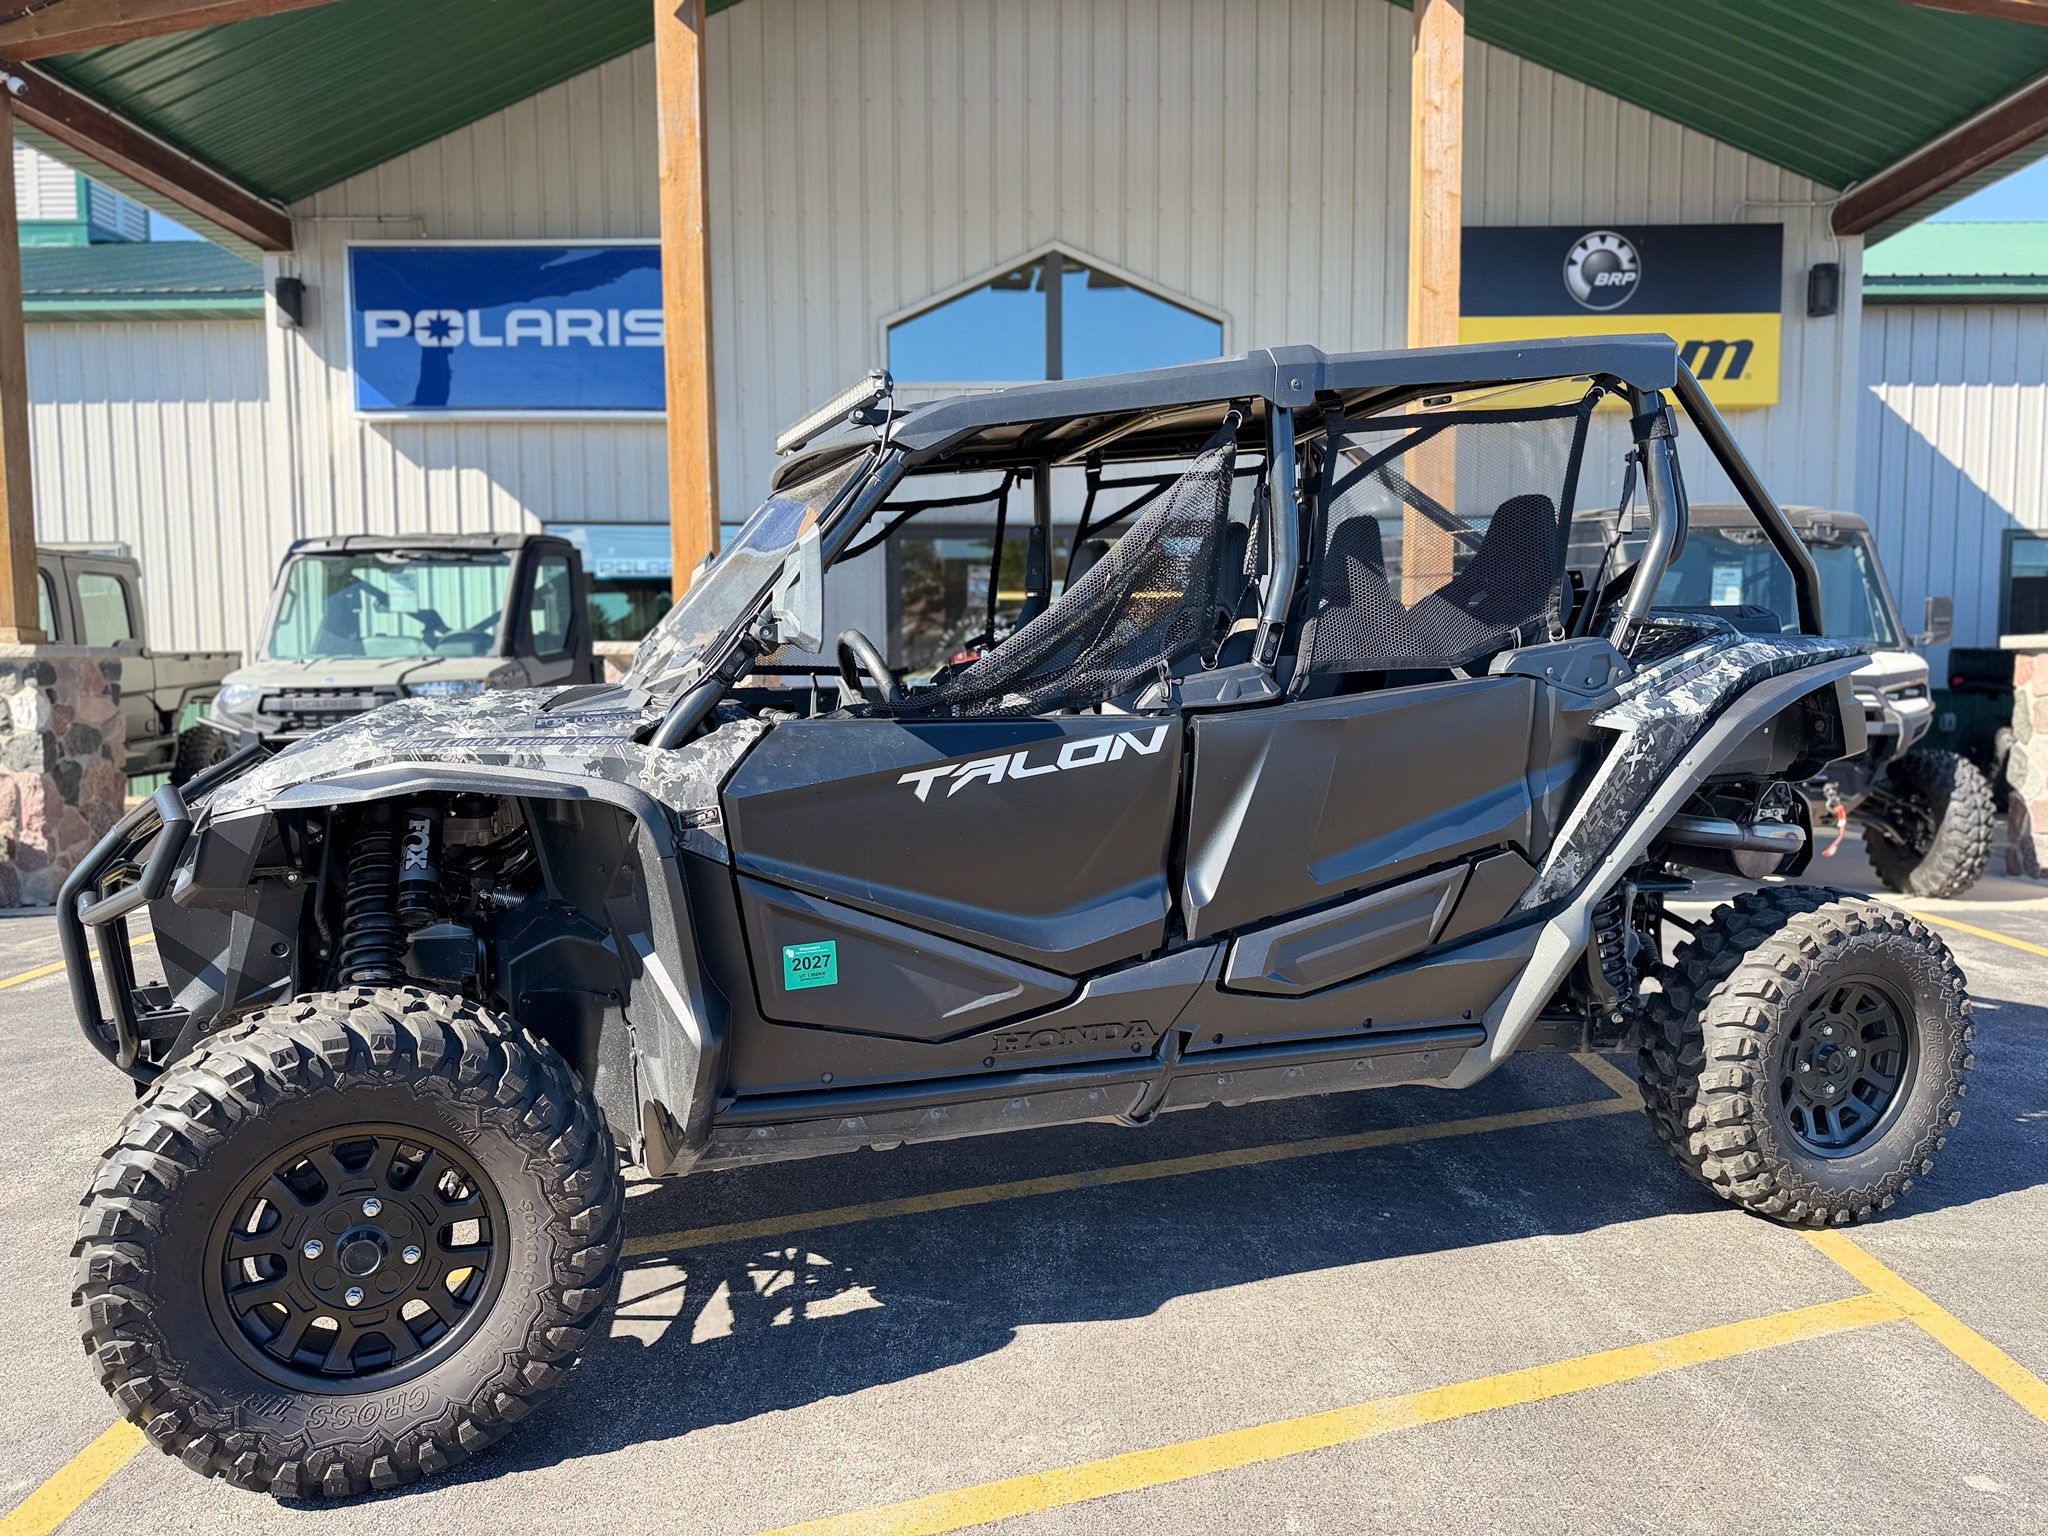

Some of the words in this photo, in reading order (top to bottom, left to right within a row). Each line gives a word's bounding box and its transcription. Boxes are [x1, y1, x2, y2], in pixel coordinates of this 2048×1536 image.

[1594, 272, 1636, 286] BRP
[364, 309, 664, 347] POLARIS
[536, 718, 569, 727] FOX
[393, 739, 441, 750] Dual
[440, 737, 501, 747] Clutch
[503, 735, 626, 746] Transmission
[897, 724, 1170, 803] TALON
[402, 819, 430, 870] FOX
[792, 953, 832, 972] 2027
[992, 1019, 1159, 1054] HONDA
[1923, 1015, 1945, 1092] CROSS
[303, 1384, 431, 1430] CROSS
